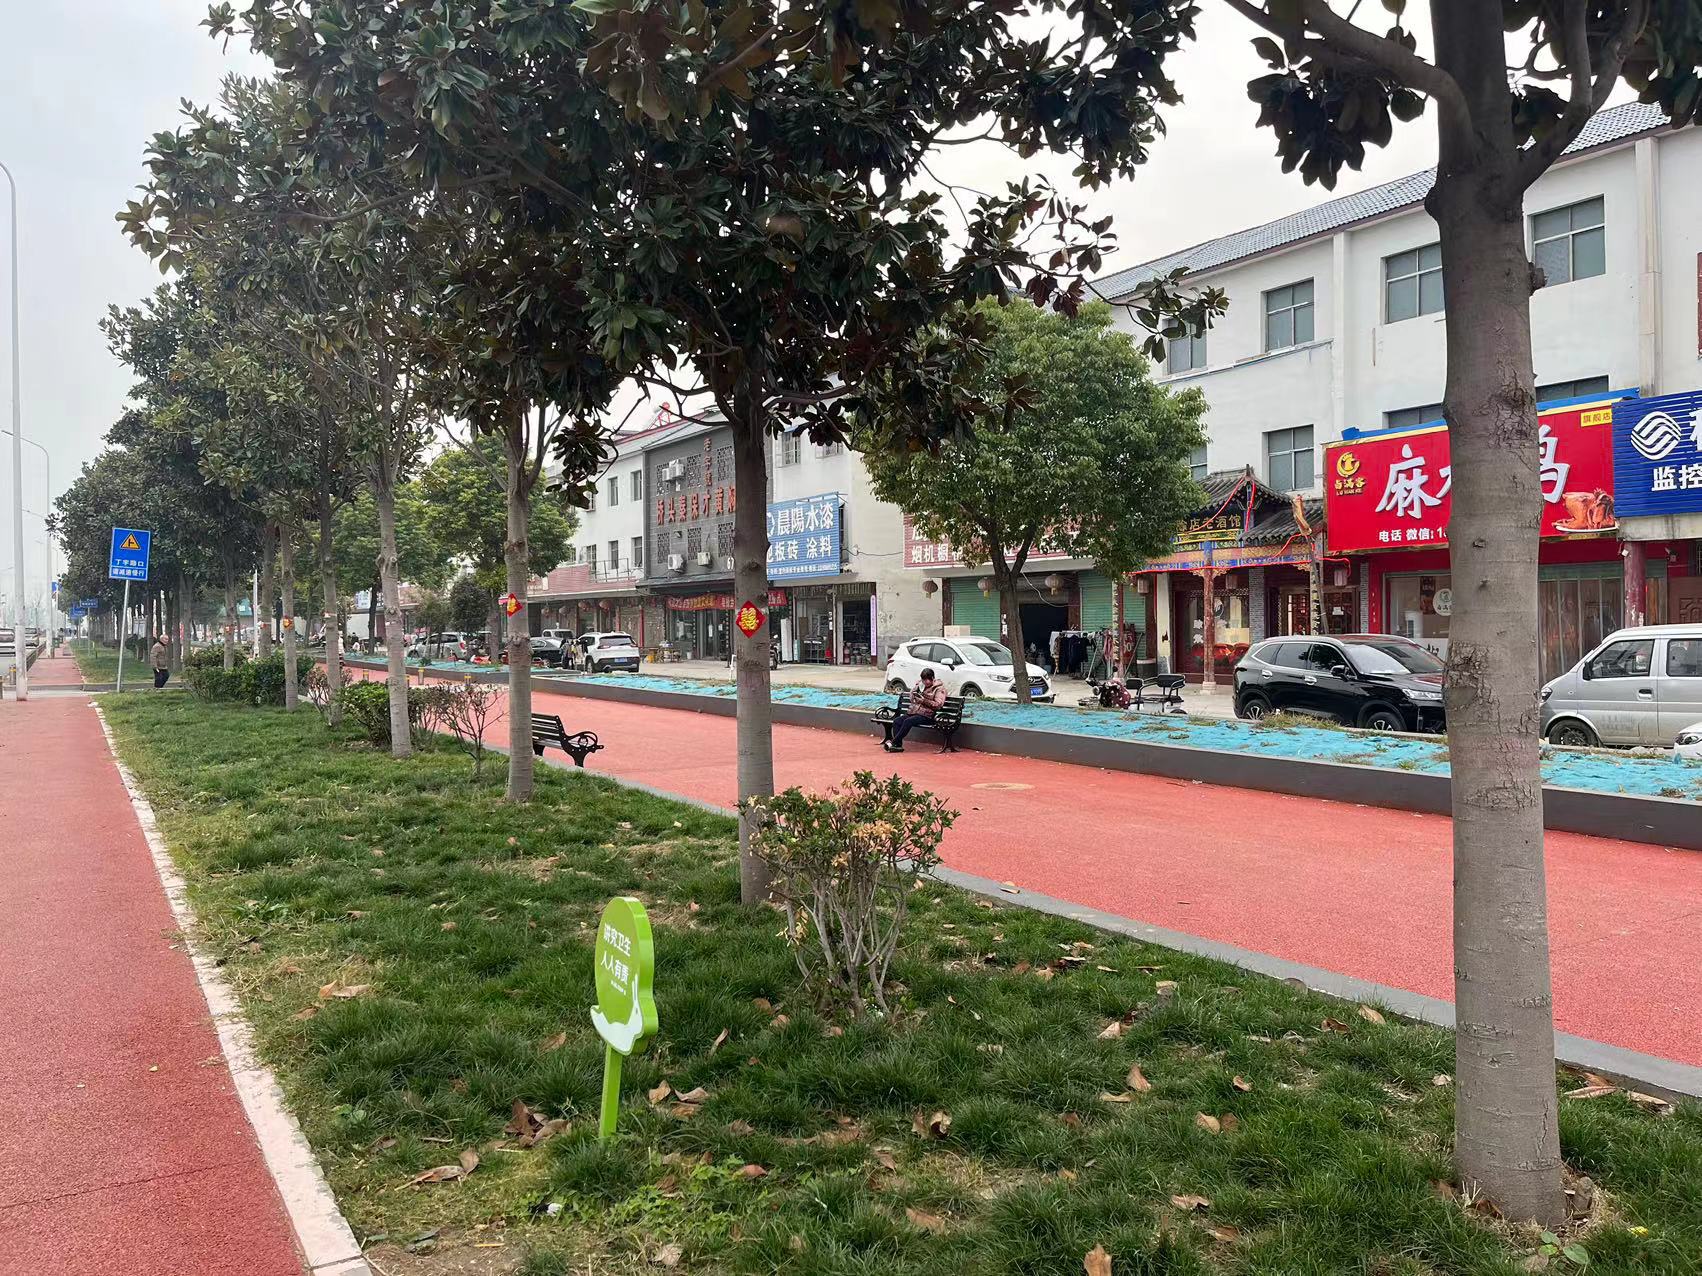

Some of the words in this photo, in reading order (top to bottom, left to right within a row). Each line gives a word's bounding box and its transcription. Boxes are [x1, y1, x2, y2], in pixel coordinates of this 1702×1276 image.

[1583, 411, 1610, 424] 旗舰店
[777, 502, 834, 537] 晨陽水漆
[1378, 529, 1402, 543] 电话
[806, 534, 832, 560] 涂料
[115, 559, 145, 567] 丁字路口
[601, 950, 629, 985] 人人有责
